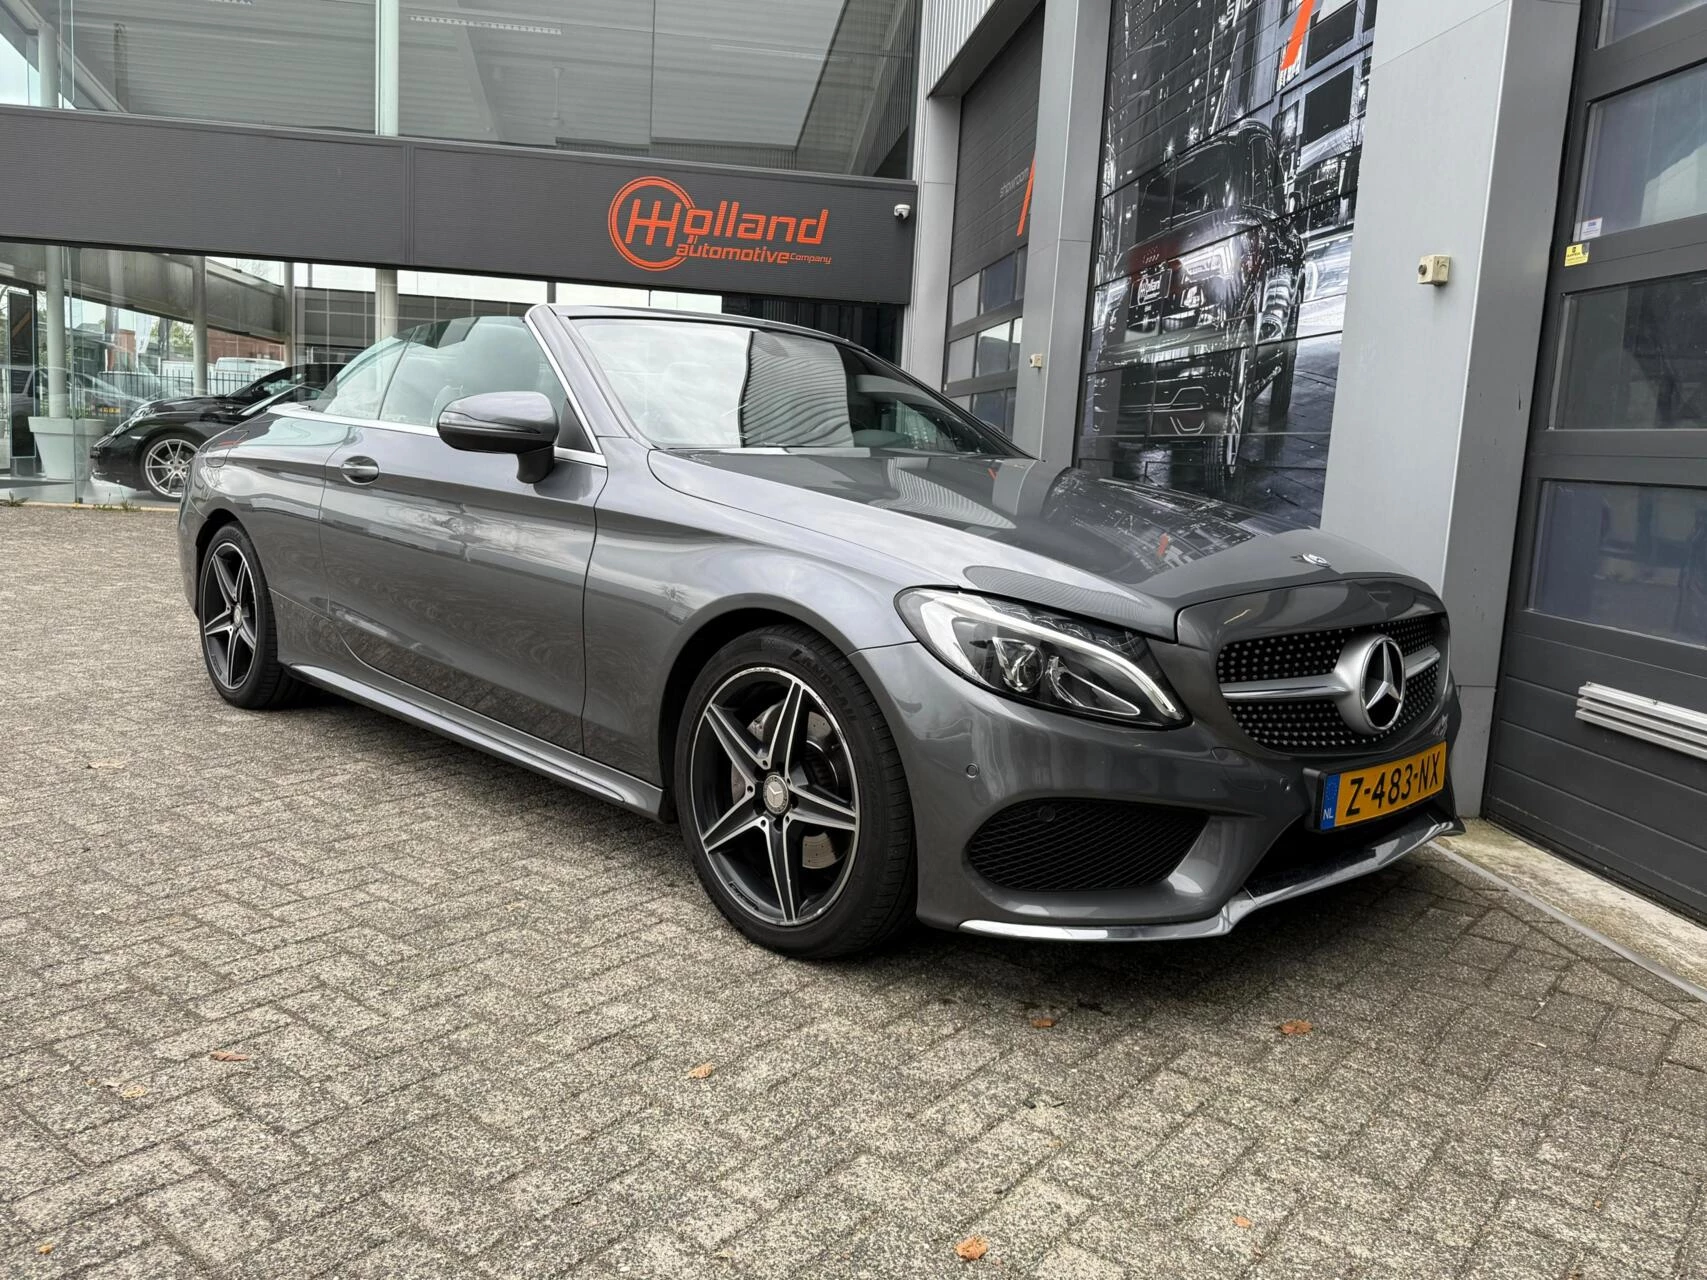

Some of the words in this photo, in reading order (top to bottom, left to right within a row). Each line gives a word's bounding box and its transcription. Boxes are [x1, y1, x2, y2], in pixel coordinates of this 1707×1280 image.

[676, 242, 790, 264] automotive
[1346, 751, 1441, 817] Z-483-NX
[1322, 808, 1334, 820] NL
